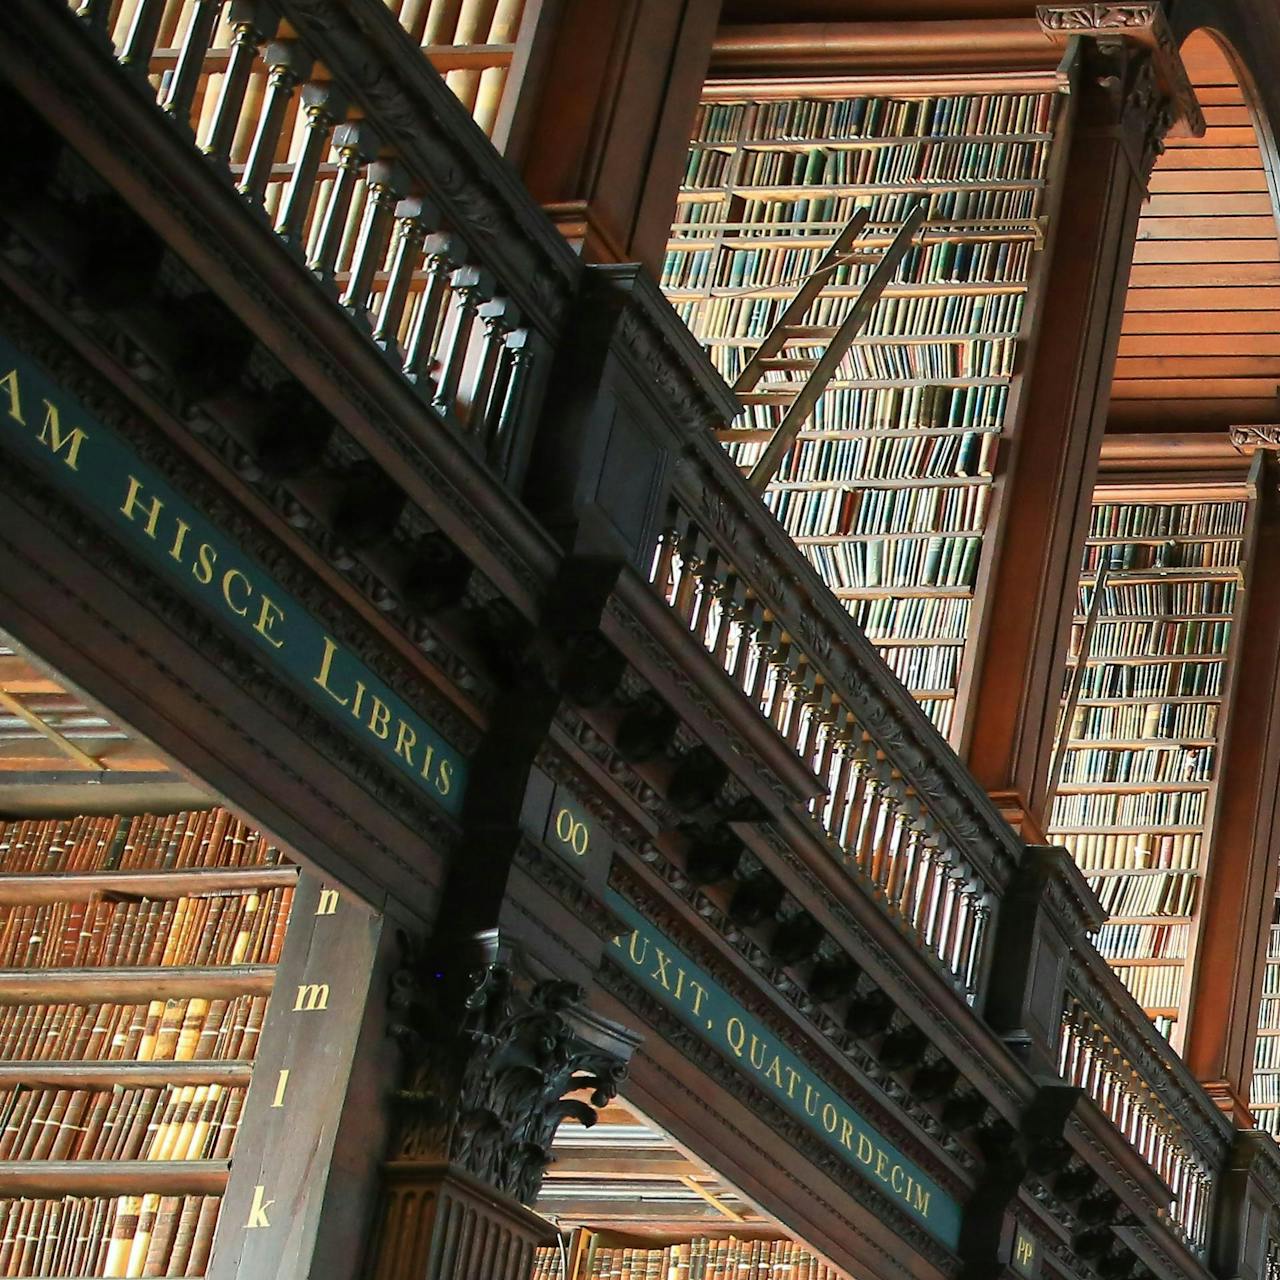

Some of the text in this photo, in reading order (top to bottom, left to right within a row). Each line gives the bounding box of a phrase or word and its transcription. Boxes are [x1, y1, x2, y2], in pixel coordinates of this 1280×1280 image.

[119, 474, 287, 650] HISCE
[311, 635, 459, 797] LIBRIS
[556, 808, 589, 856] OO
[315, 890, 339, 915] n
[293, 985, 328, 1011] m
[271, 1070, 289, 1107] l
[726, 1017, 931, 1218] QUATUORDECIM
[243, 1186, 275, 1228] k
[1017, 1236, 1033, 1265] PP
